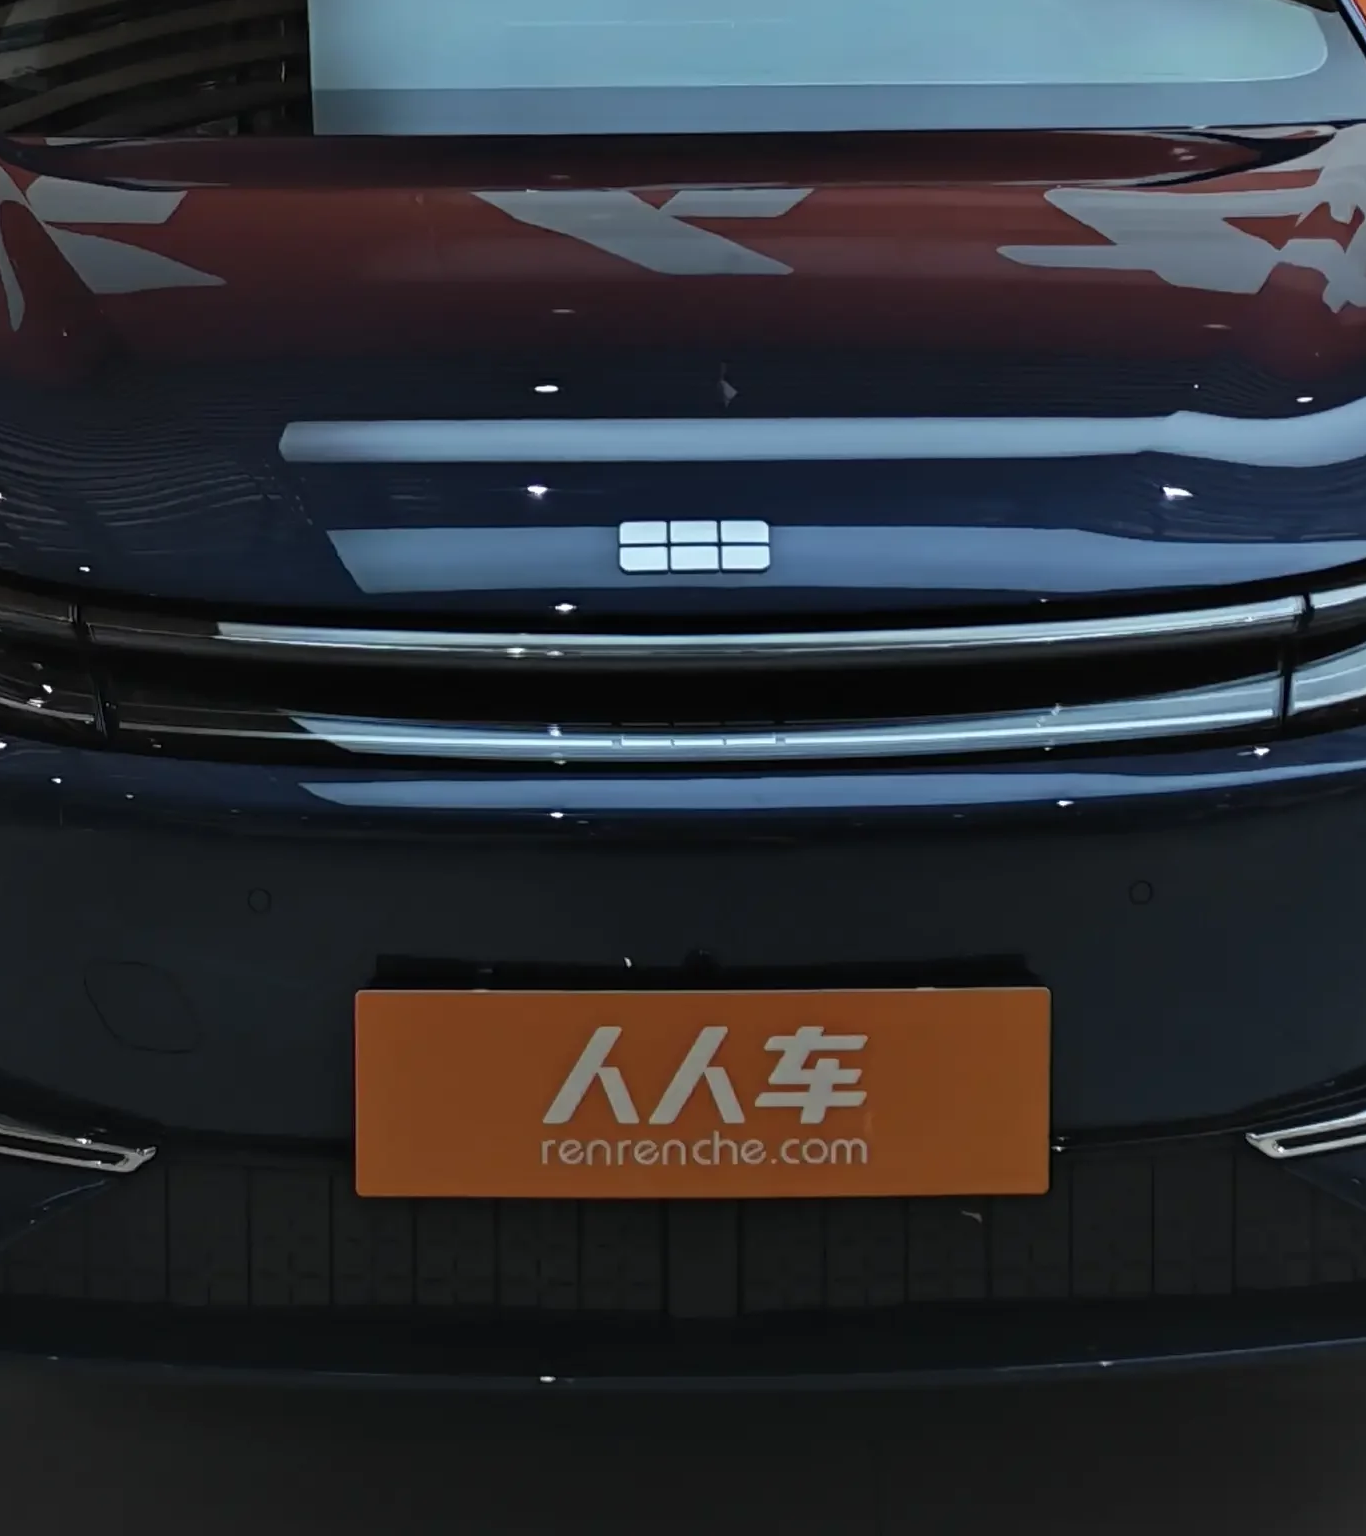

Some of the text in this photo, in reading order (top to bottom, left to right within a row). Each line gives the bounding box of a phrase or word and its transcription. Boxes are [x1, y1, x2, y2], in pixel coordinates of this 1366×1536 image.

[542, 1026, 868, 1124] 人人车
[541, 1130, 868, 1165] renrenche.com
